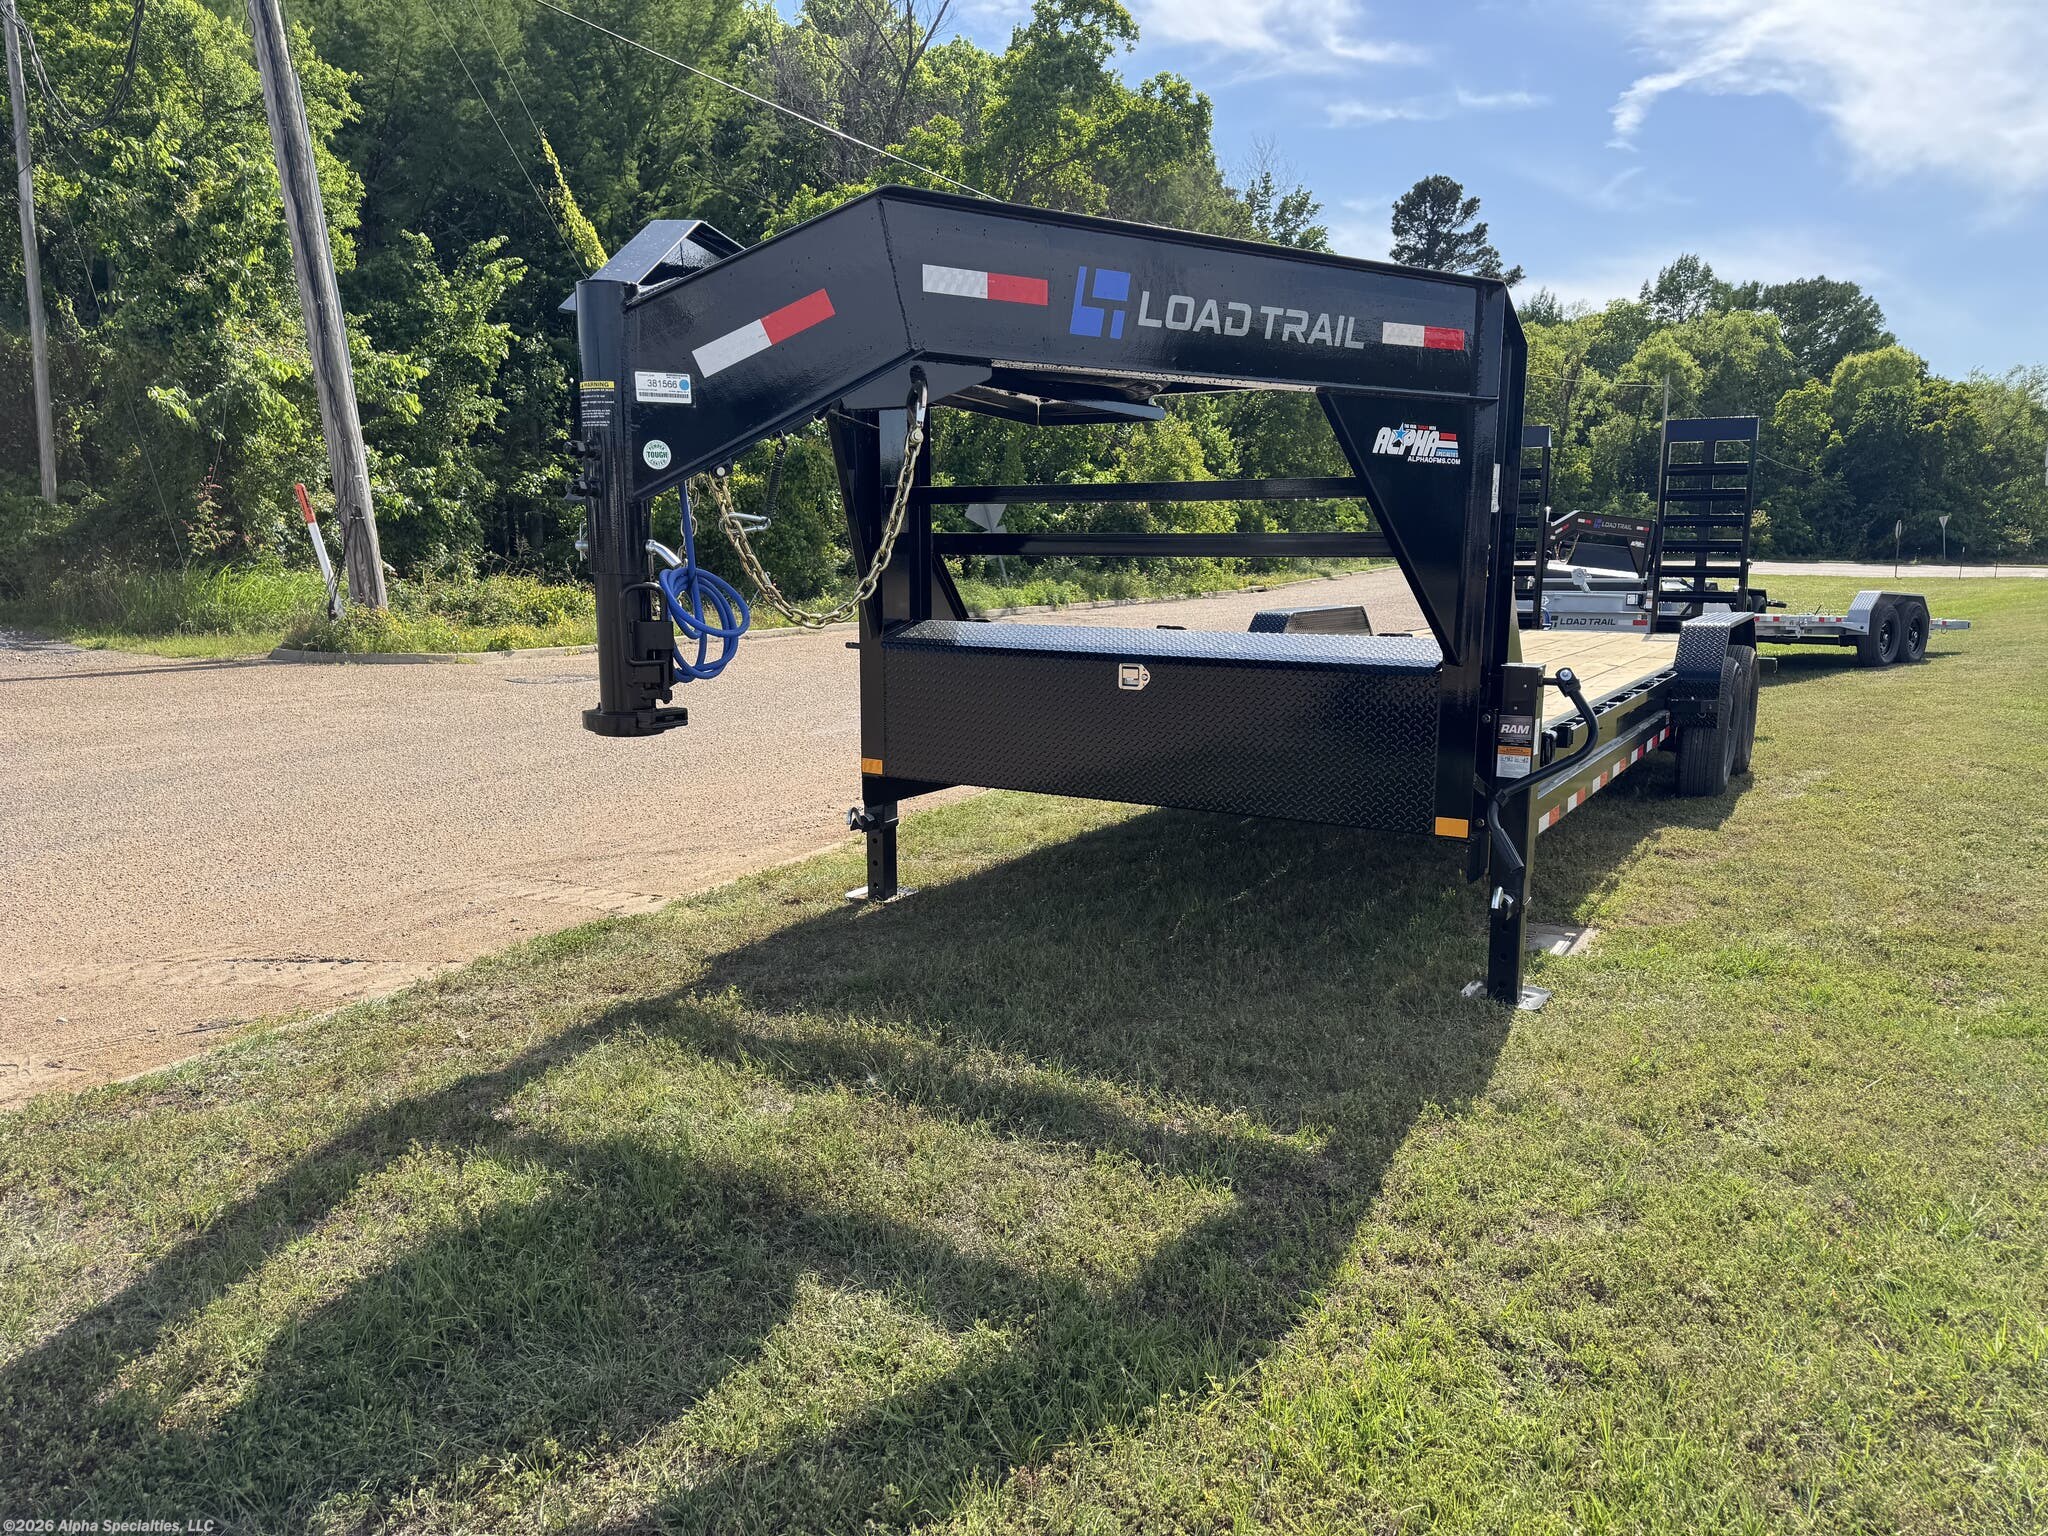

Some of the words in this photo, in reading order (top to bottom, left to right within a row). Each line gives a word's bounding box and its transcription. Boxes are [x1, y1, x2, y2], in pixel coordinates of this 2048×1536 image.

[1137, 290, 1252, 338] LOAD
[1260, 305, 1365, 350] TRAIL
[647, 379, 678, 389] 381566
[1372, 426, 1440, 457] ALPHA
[646, 451, 668, 459] TOUGH
[1407, 455, 1461, 465] ALPHAOFMS.COM
[1601, 521, 1617, 529] LOAD
[1617, 523, 1633, 531] TRAIL
[1560, 617, 1587, 626] LOAD
[1587, 617, 1616, 626] TRAIL
[1500, 724, 1530, 734] RAM
